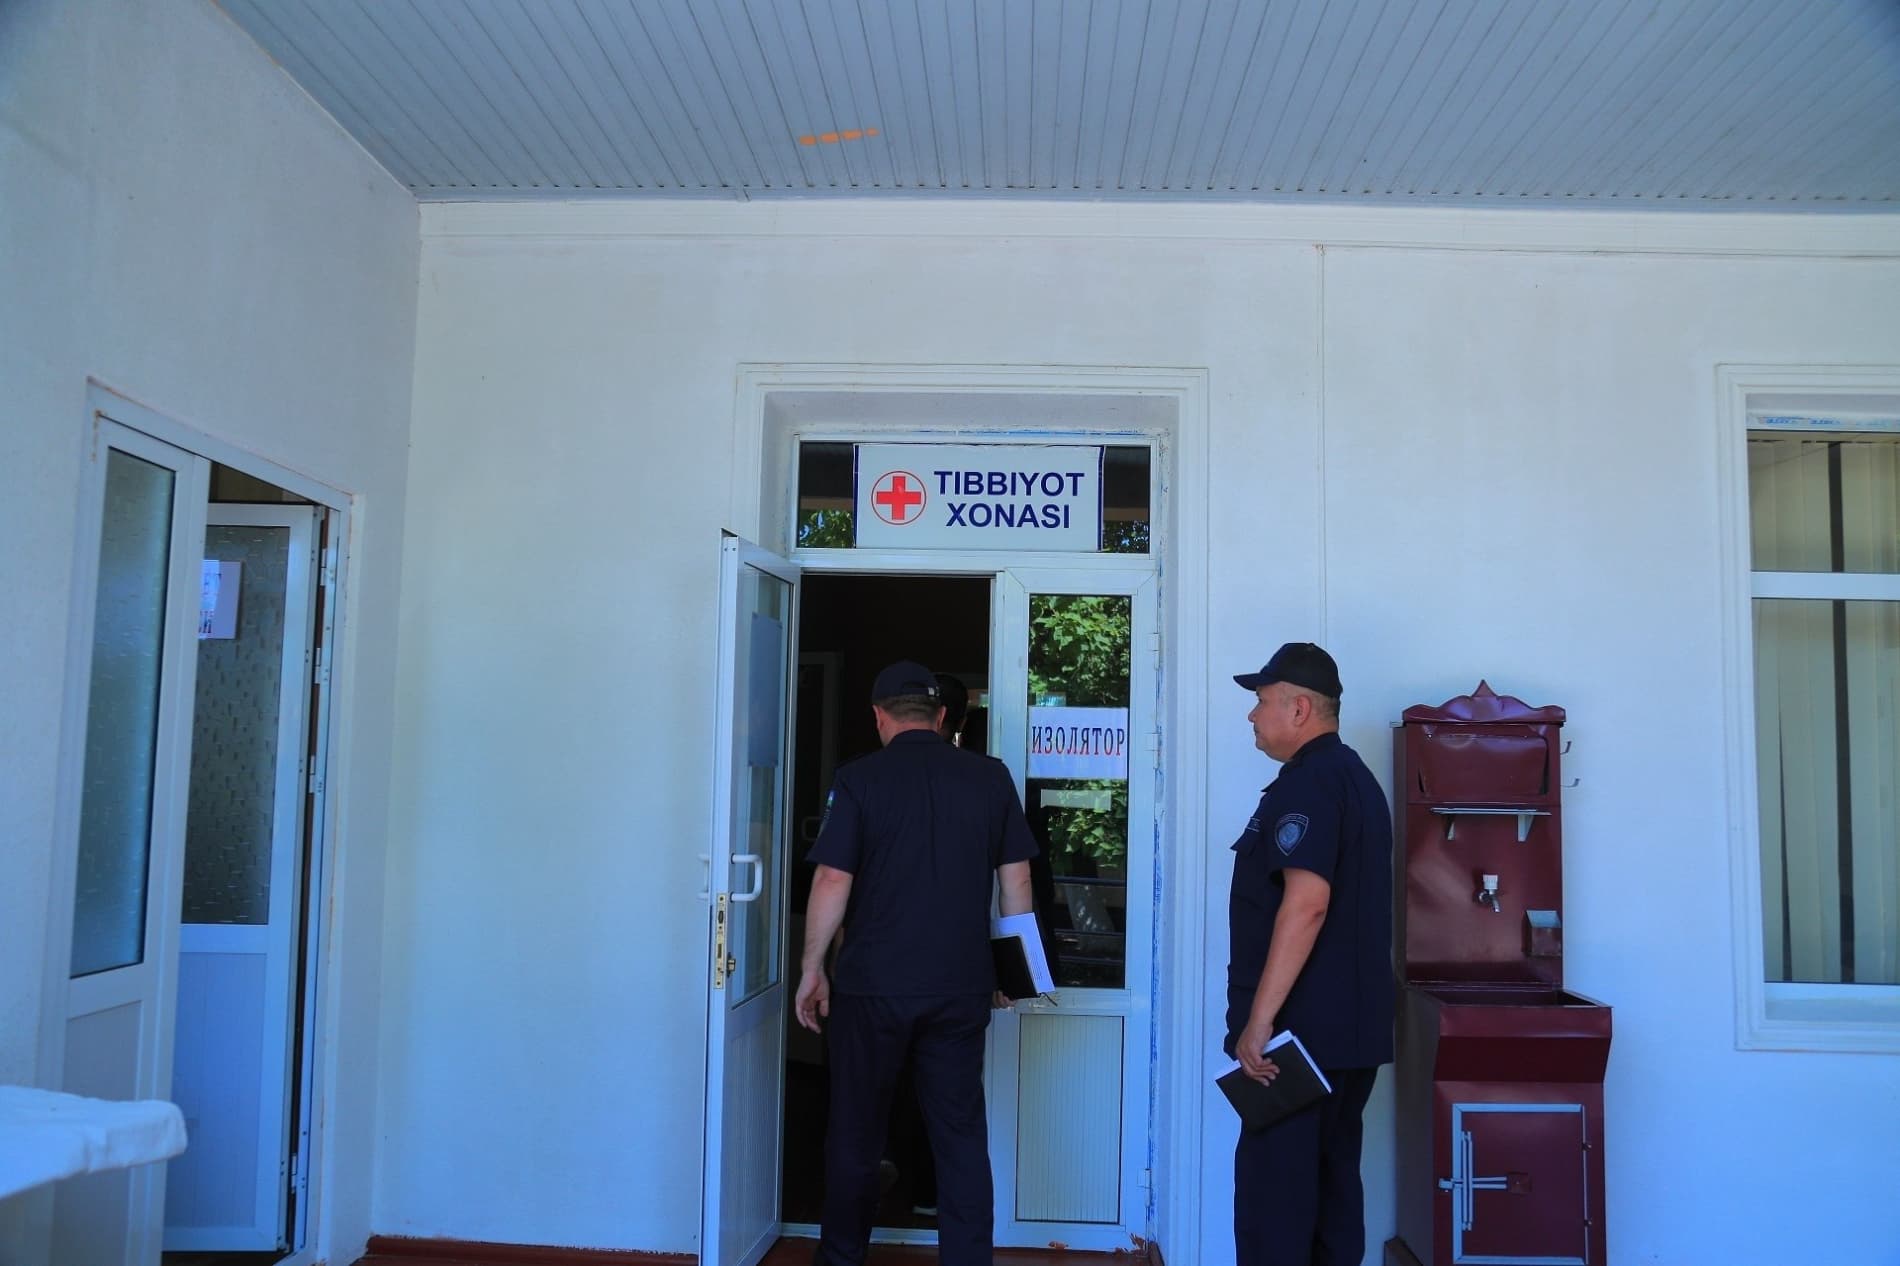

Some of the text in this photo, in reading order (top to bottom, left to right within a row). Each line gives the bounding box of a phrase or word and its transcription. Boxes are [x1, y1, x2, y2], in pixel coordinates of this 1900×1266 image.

[933, 470, 1085, 497] TIBBIYOT
[945, 502, 1070, 529] XONASI
[1031, 726, 1125, 756] ИЗОЛЯТОР
